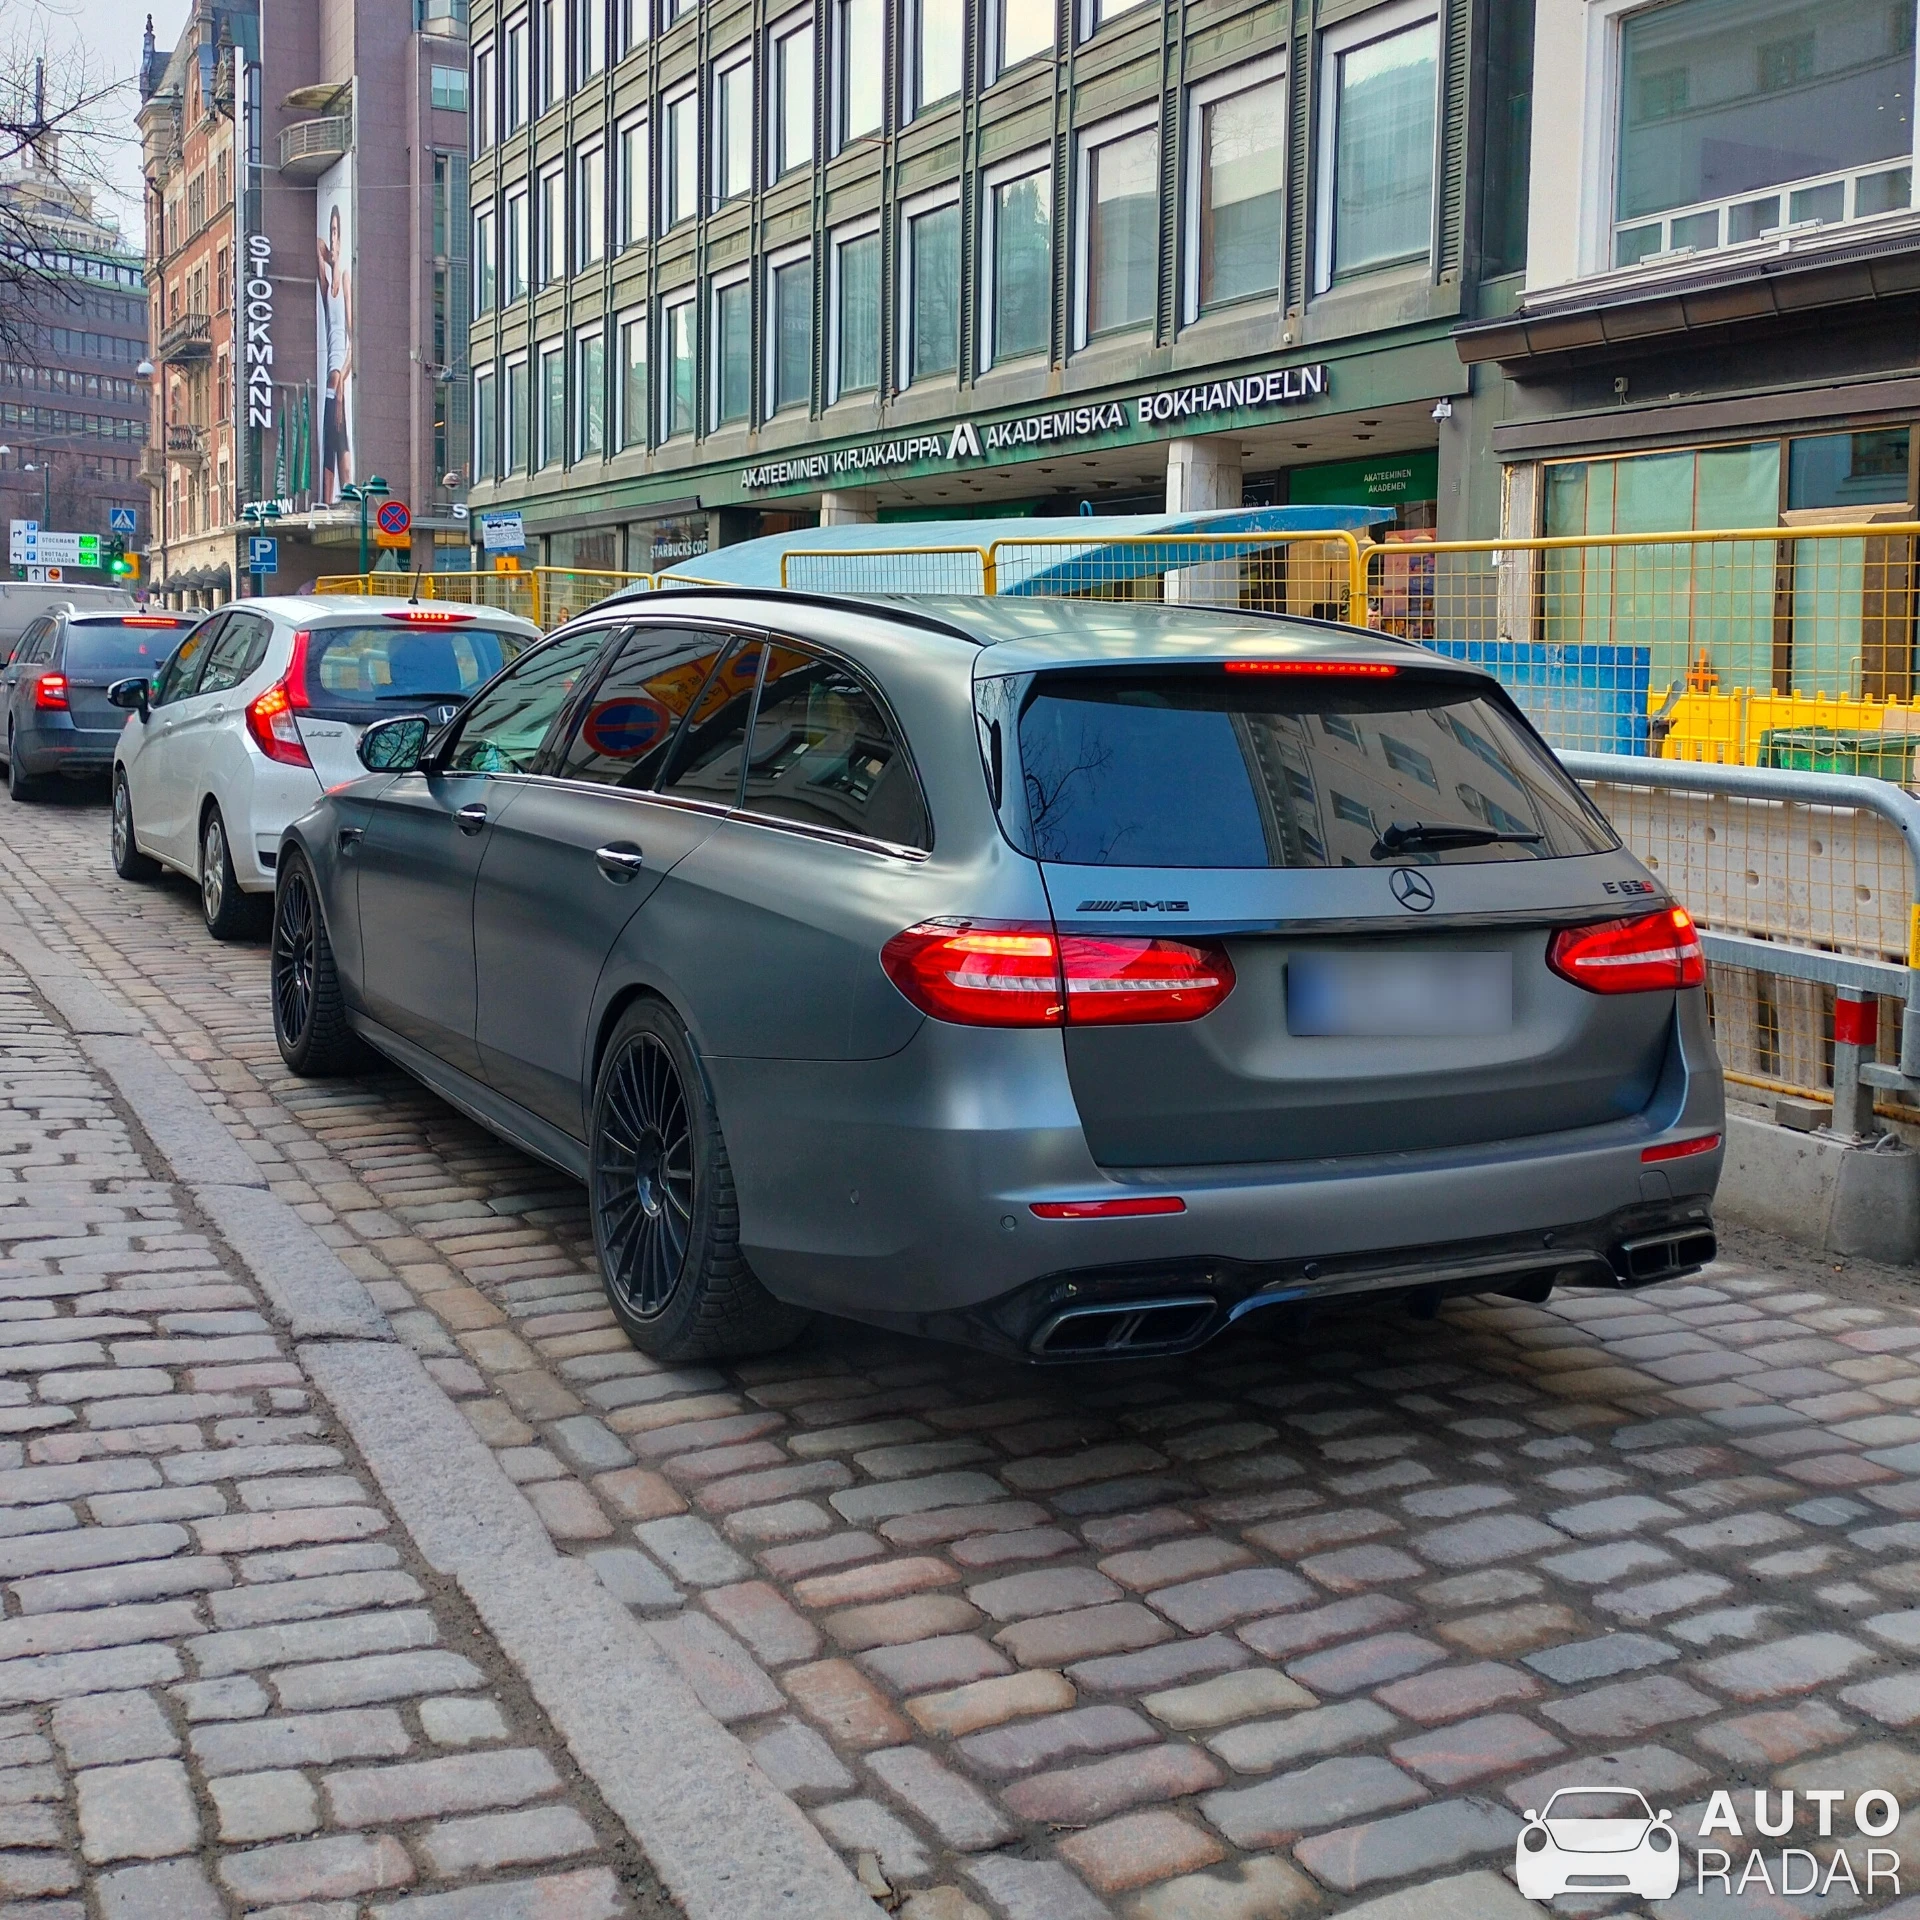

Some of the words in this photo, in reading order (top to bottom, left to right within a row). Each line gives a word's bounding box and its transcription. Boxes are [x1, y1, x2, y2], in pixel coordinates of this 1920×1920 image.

[247, 235, 273, 429] STOCKMANN
[741, 453, 829, 488] AKATEEMINEN
[833, 435, 942, 473] KIRJAKAUPPA
[986, 403, 1124, 449] AKADEMISKA
[1138, 364, 1327, 423] BOKHANDELN
[1363, 468, 1412, 482] AKATEEMINEN
[1368, 481, 1407, 493] AKADEMEN
[650, 541, 692, 559] STARBUCKS
